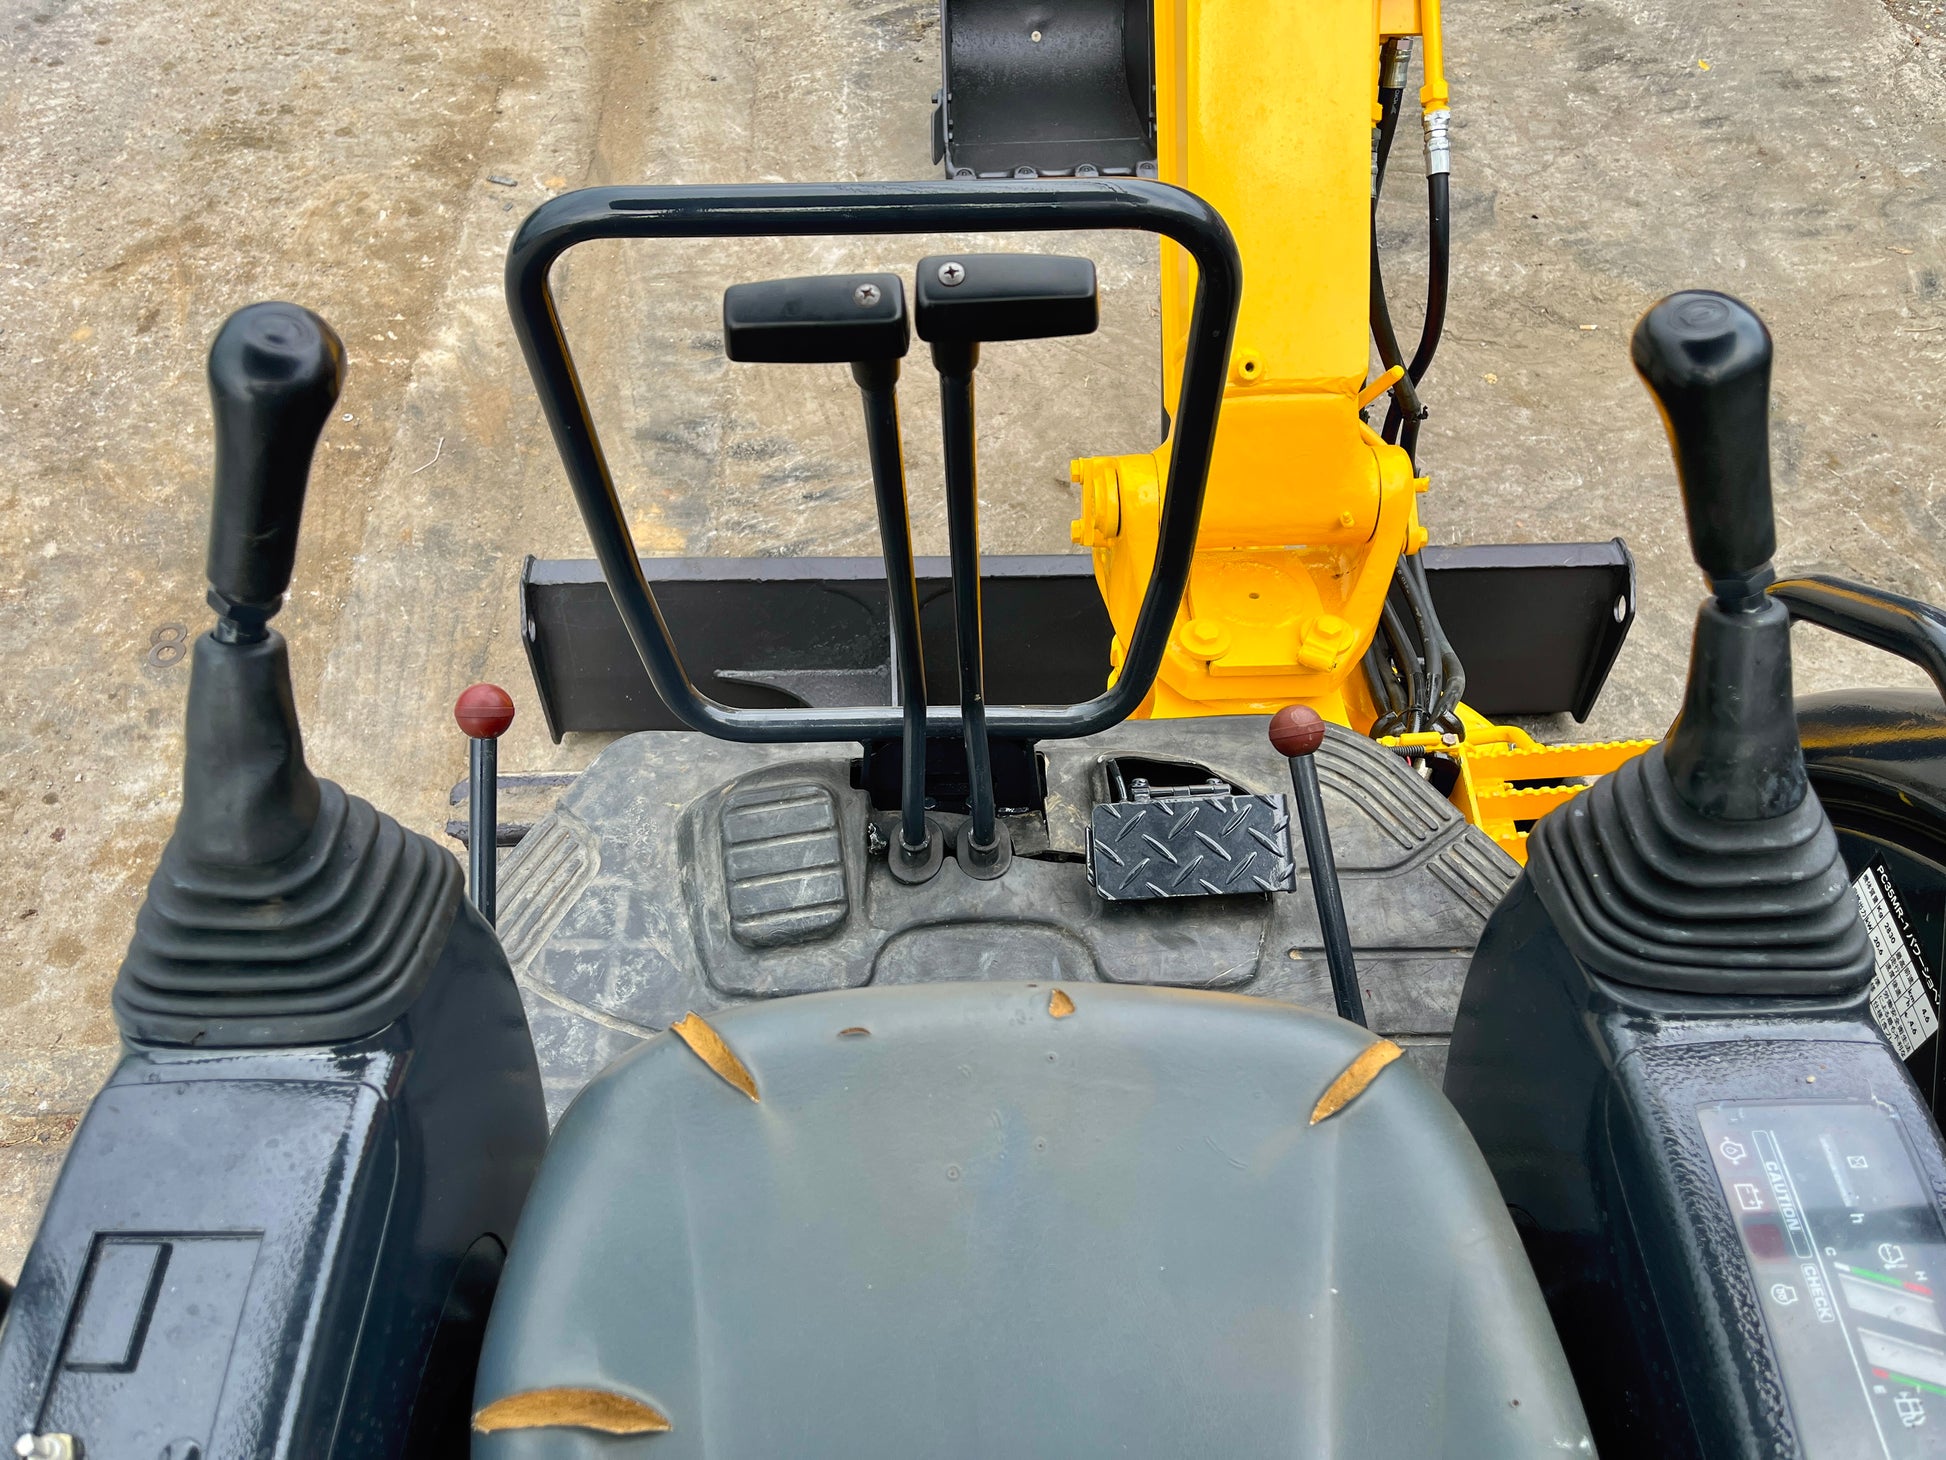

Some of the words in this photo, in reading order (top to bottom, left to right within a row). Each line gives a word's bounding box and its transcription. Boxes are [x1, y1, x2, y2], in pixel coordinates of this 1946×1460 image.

[1877, 865, 1909, 930] PC35MR-1
[1884, 922, 1895, 943] 2830
[1874, 936, 1883, 955] 20.6
[1765, 1160, 1801, 1232] CAUTION
[1850, 1213, 1865, 1224] h
[1824, 1246, 1837, 1257] C
[1915, 1270, 1928, 1281] H
[1803, 1265, 1833, 1321] CHECK
